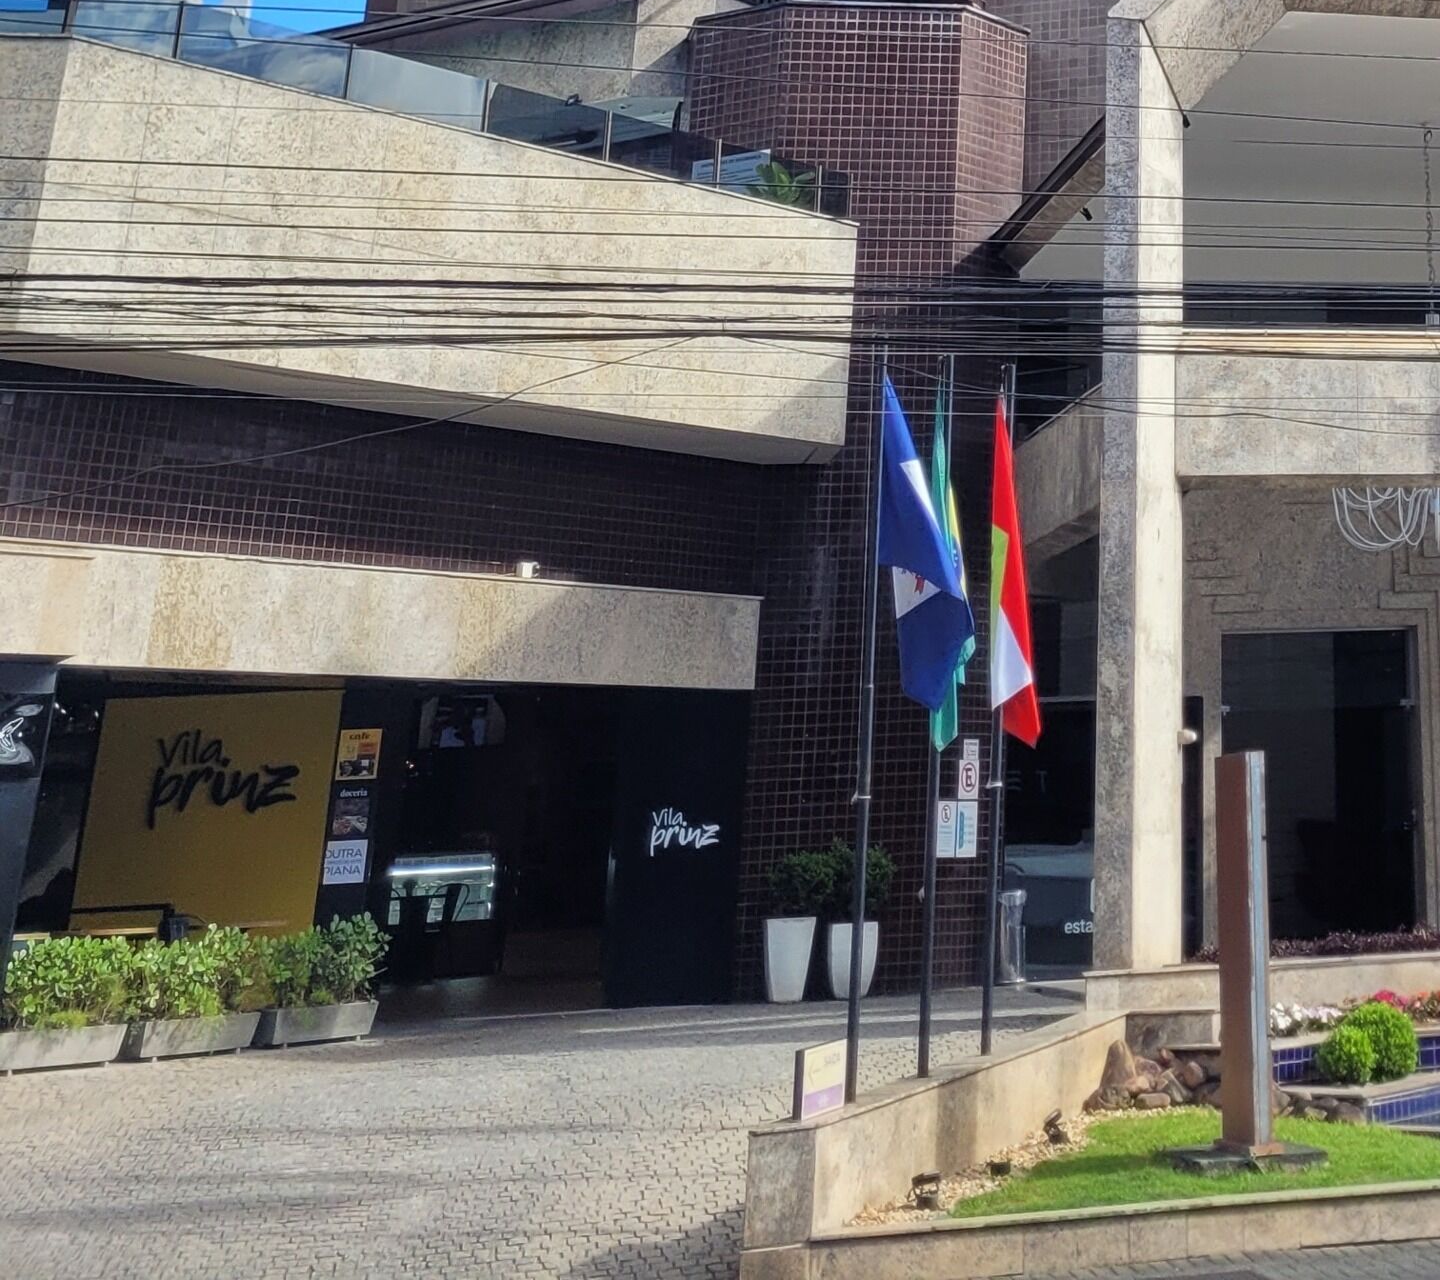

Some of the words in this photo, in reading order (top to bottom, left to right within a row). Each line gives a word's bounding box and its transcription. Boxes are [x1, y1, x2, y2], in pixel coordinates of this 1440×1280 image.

[156, 728, 224, 767] Vila
[147, 757, 301, 831] prinz
[652, 807, 684, 827] Vila
[650, 822, 721, 857] prinz
